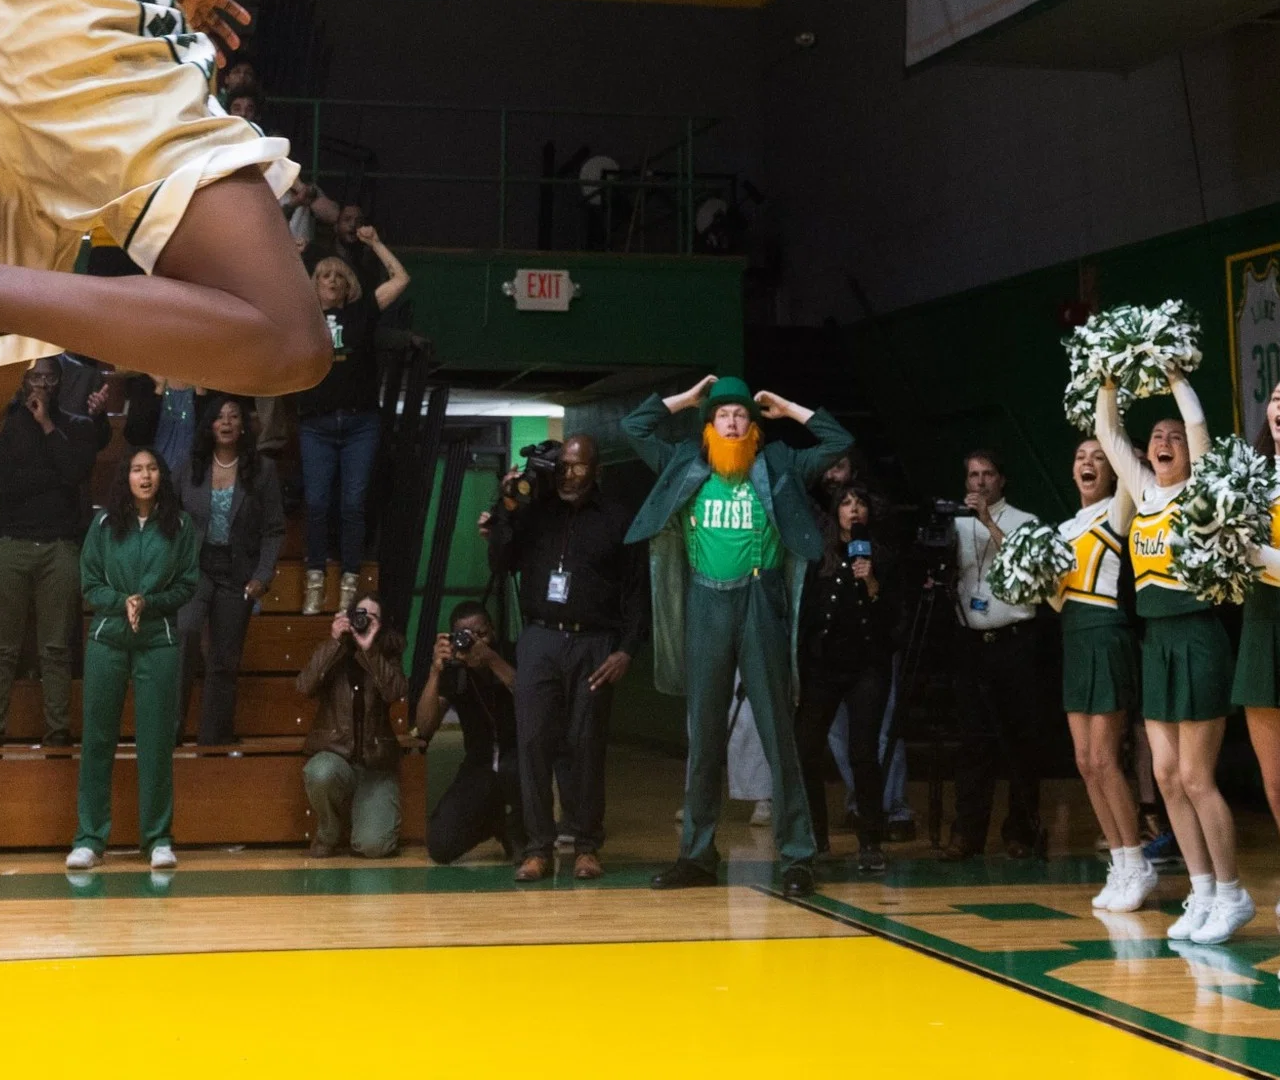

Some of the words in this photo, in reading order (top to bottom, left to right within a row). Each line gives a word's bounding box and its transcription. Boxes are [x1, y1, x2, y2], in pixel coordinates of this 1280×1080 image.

[527, 271, 563, 299] EXIT
[1251, 341, 1280, 403] 30
[702, 499, 754, 530] IRISH
[1133, 530, 1165, 555] Irish
